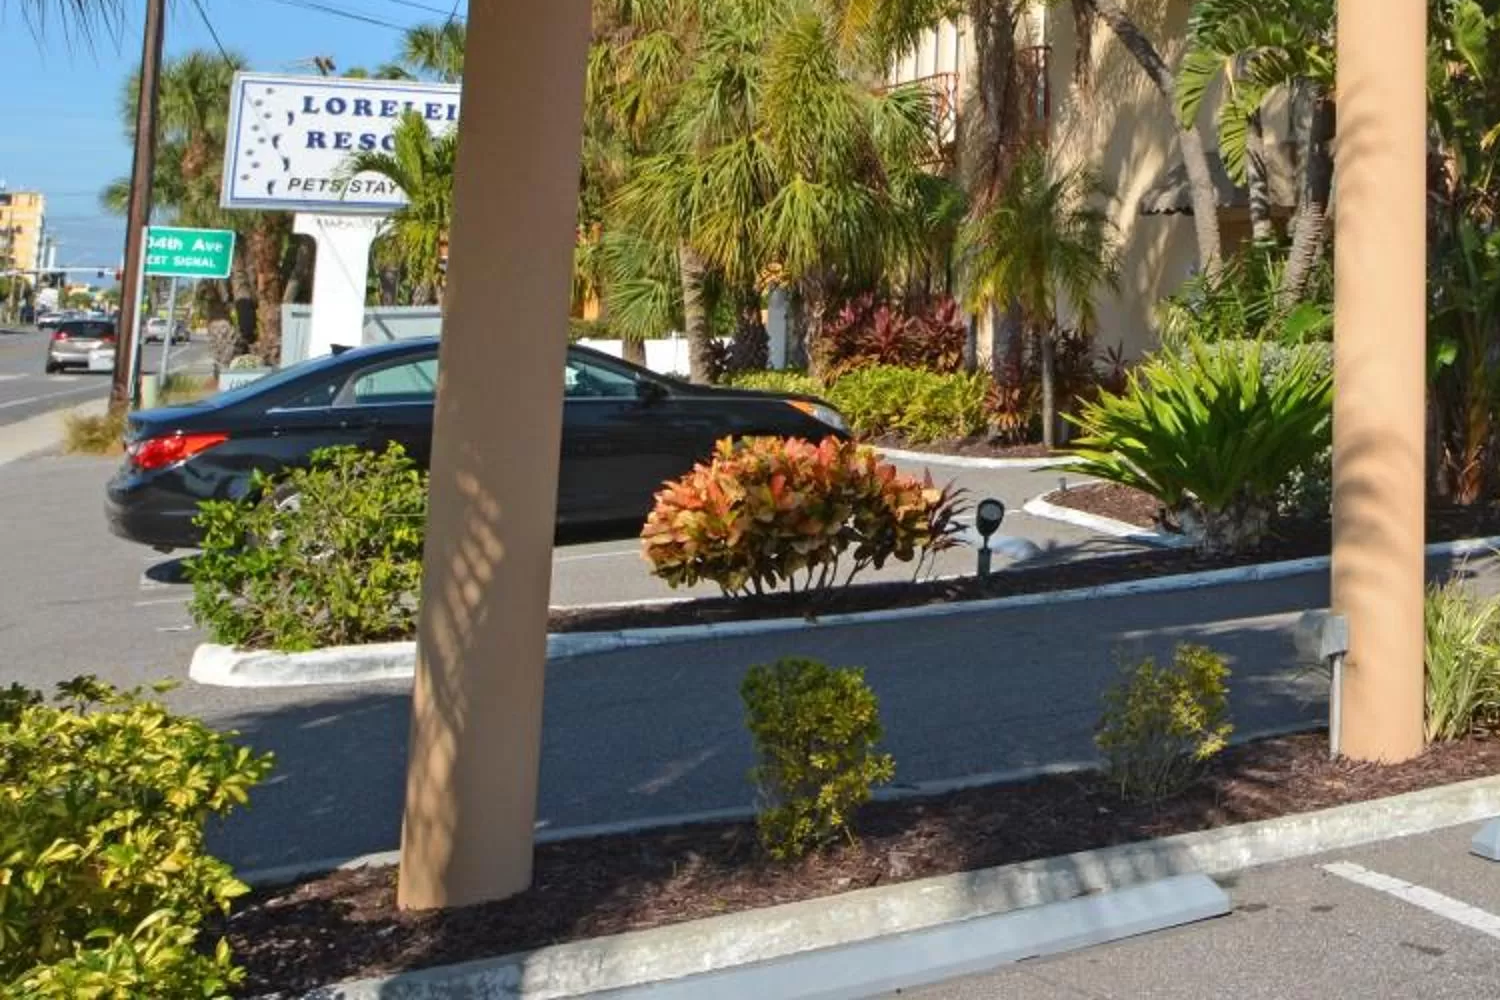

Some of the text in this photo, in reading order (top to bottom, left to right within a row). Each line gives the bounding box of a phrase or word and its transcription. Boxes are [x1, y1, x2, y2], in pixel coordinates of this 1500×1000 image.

[305, 131, 437, 151] RESO
[287, 177, 399, 195] PETS STAY
[192, 238, 224, 253] Ave
[173, 255, 217, 269] SIGNAL
